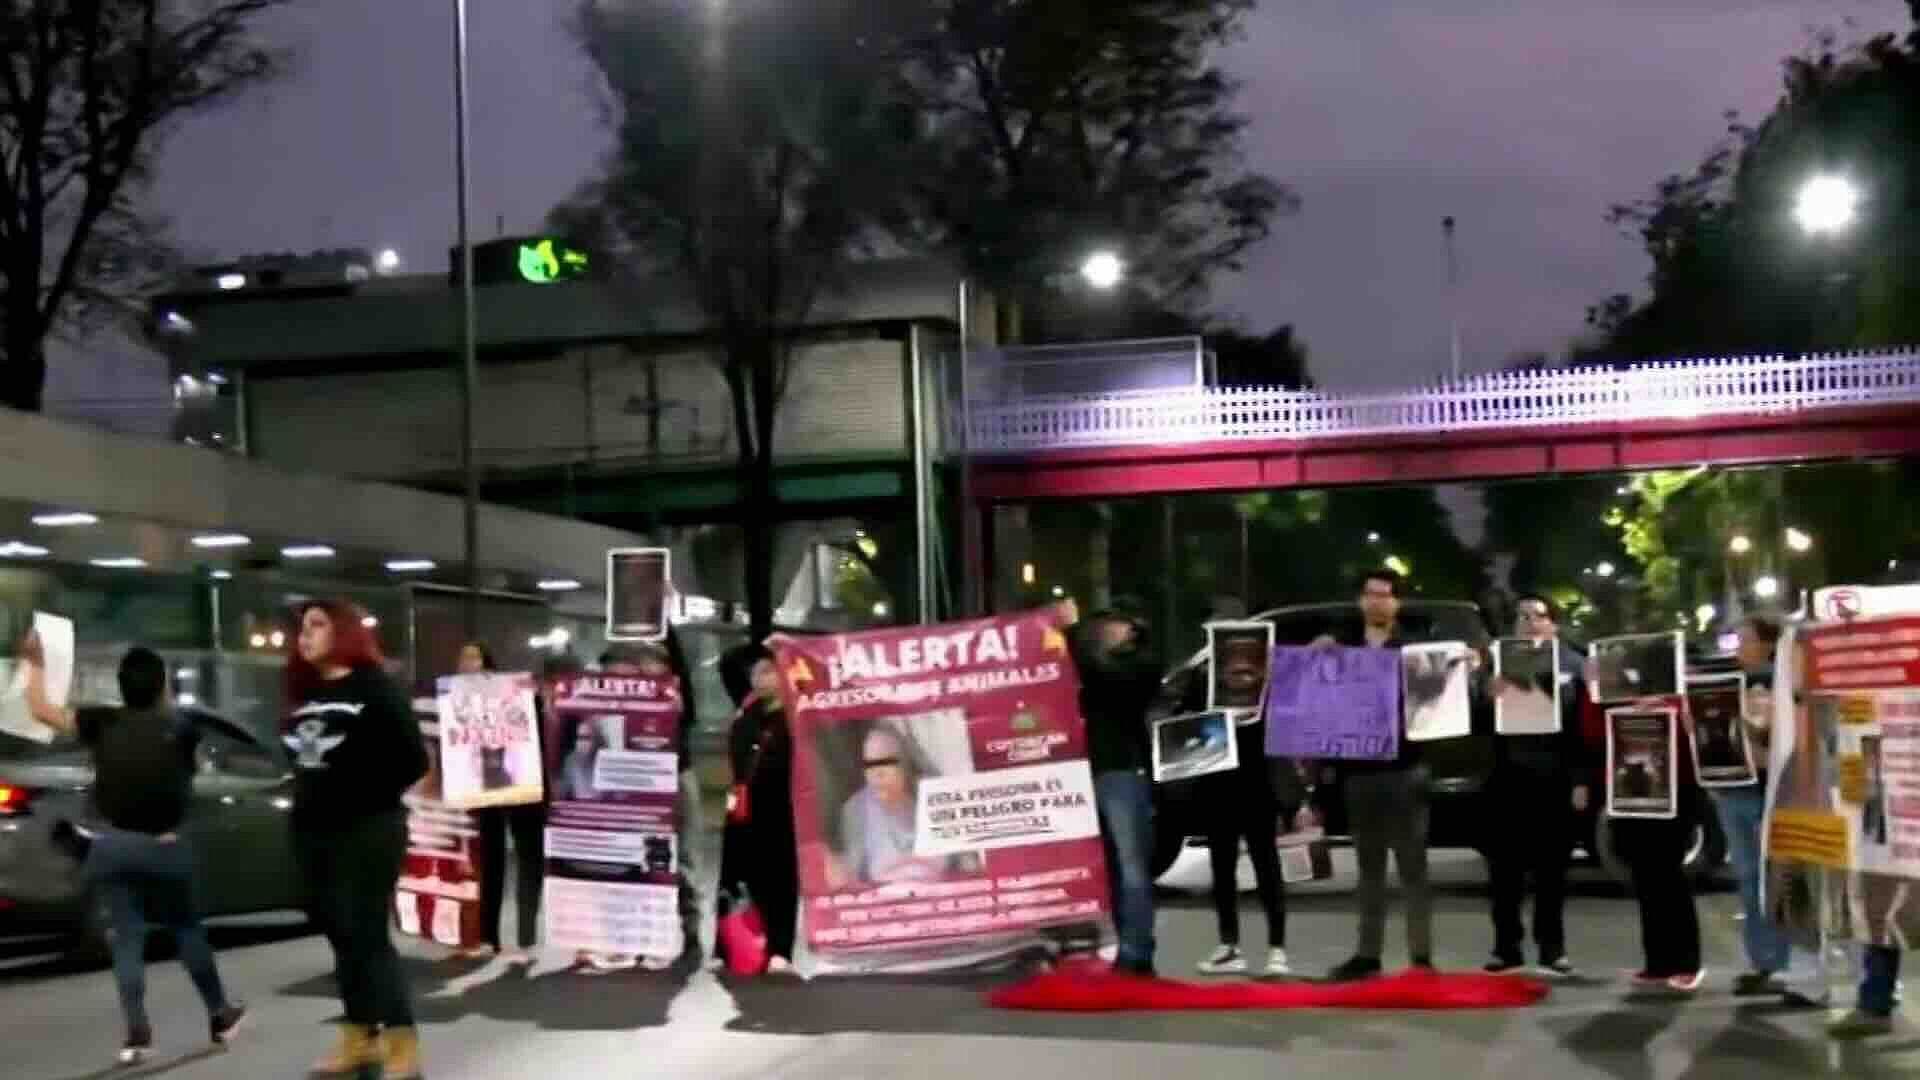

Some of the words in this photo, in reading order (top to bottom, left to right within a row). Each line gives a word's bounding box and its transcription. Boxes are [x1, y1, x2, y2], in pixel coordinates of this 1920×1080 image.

[947, 662, 1060, 695] ANIMALES
[960, 798, 1035, 819] PELIGRO
[1040, 790, 1087, 809] PARA
